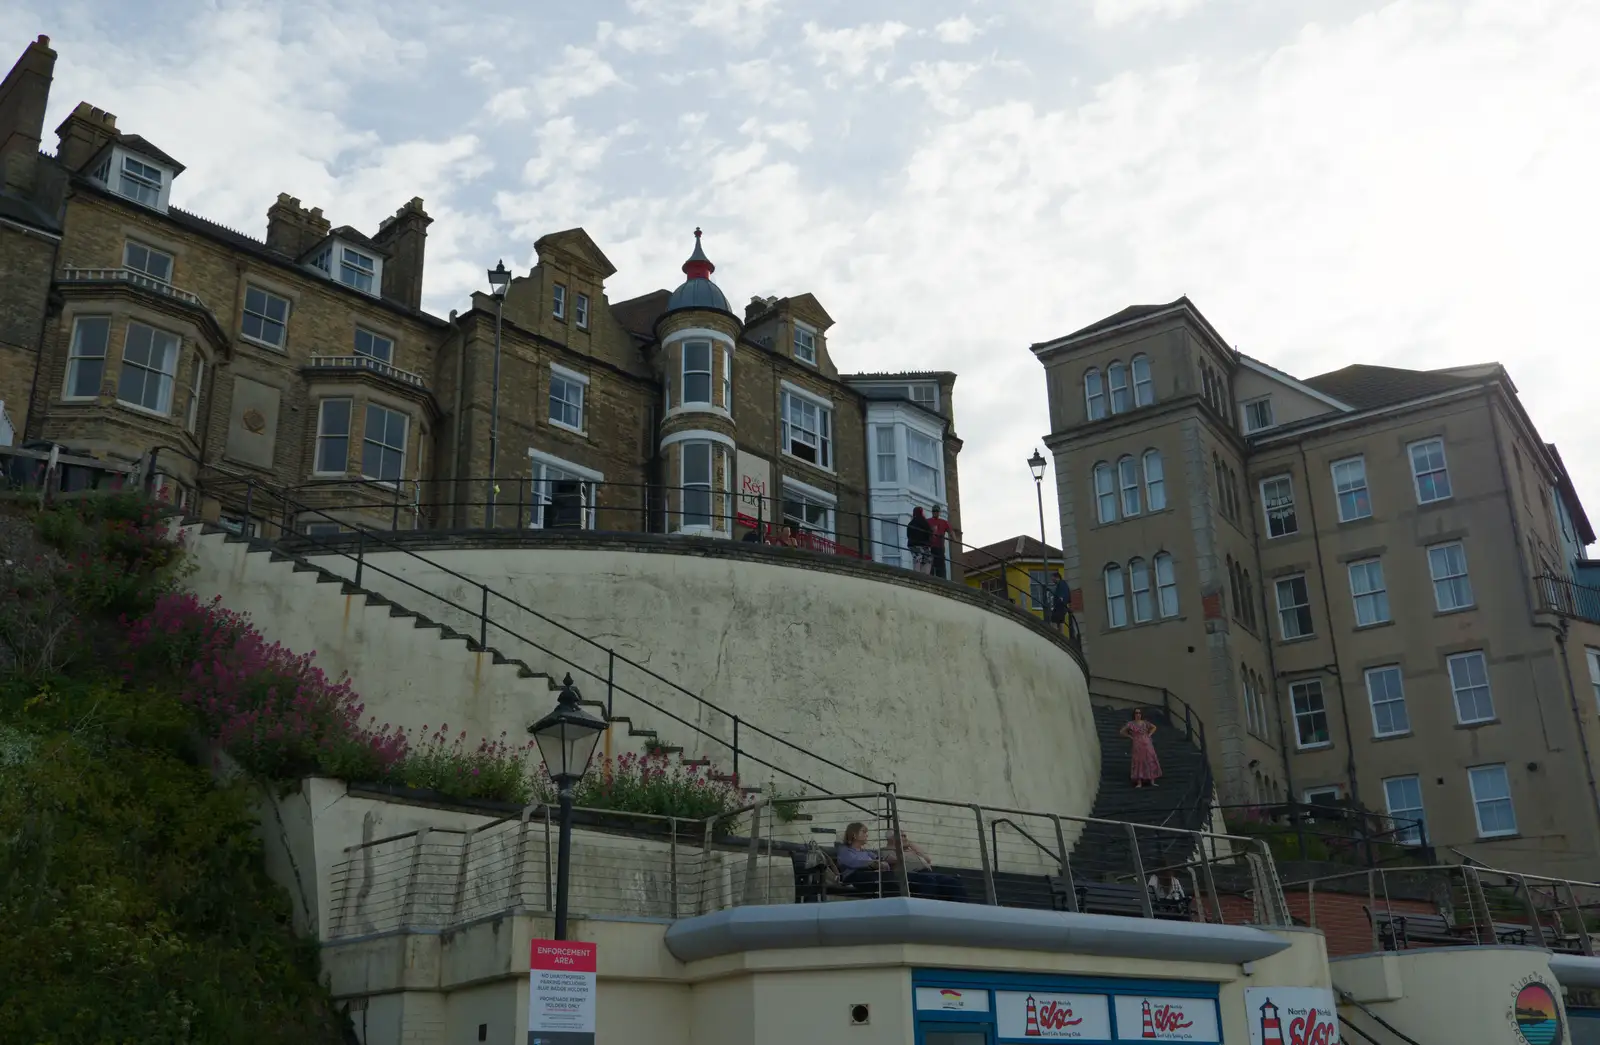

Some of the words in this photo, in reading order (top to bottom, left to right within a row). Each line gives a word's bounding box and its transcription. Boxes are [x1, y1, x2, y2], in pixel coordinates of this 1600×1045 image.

[742, 475, 766, 495] Red
[742, 489, 767, 511] Lion
[537, 947, 591, 957] ENFORCEMENT
[554, 957, 574, 965] AREA
